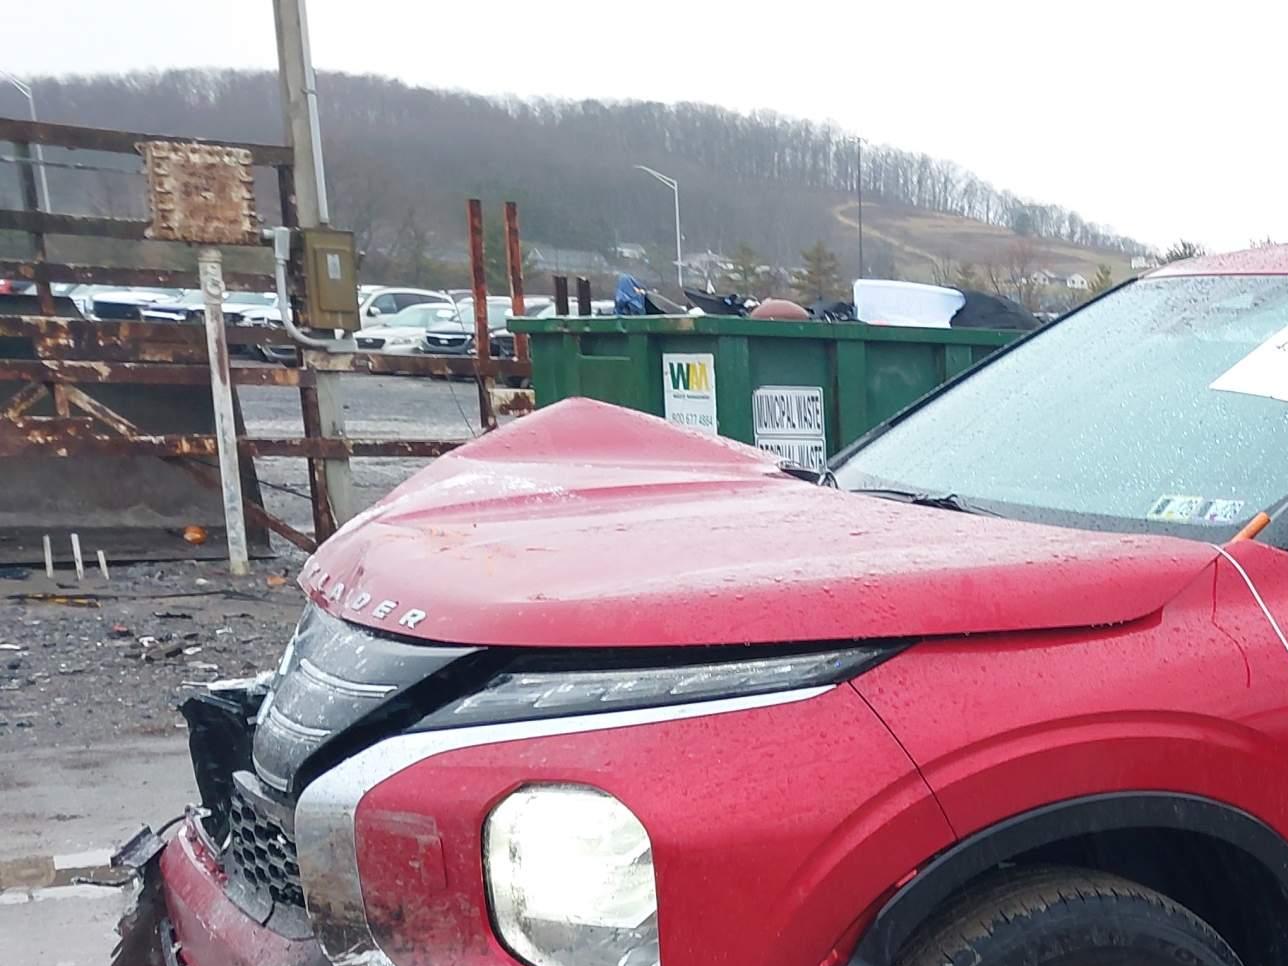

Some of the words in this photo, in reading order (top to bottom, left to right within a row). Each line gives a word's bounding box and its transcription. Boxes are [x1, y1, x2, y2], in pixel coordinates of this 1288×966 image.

[669, 362, 709, 391] WM
[756, 394, 796, 429] MUNICIPAL
[797, 395, 821, 430] WASTE
